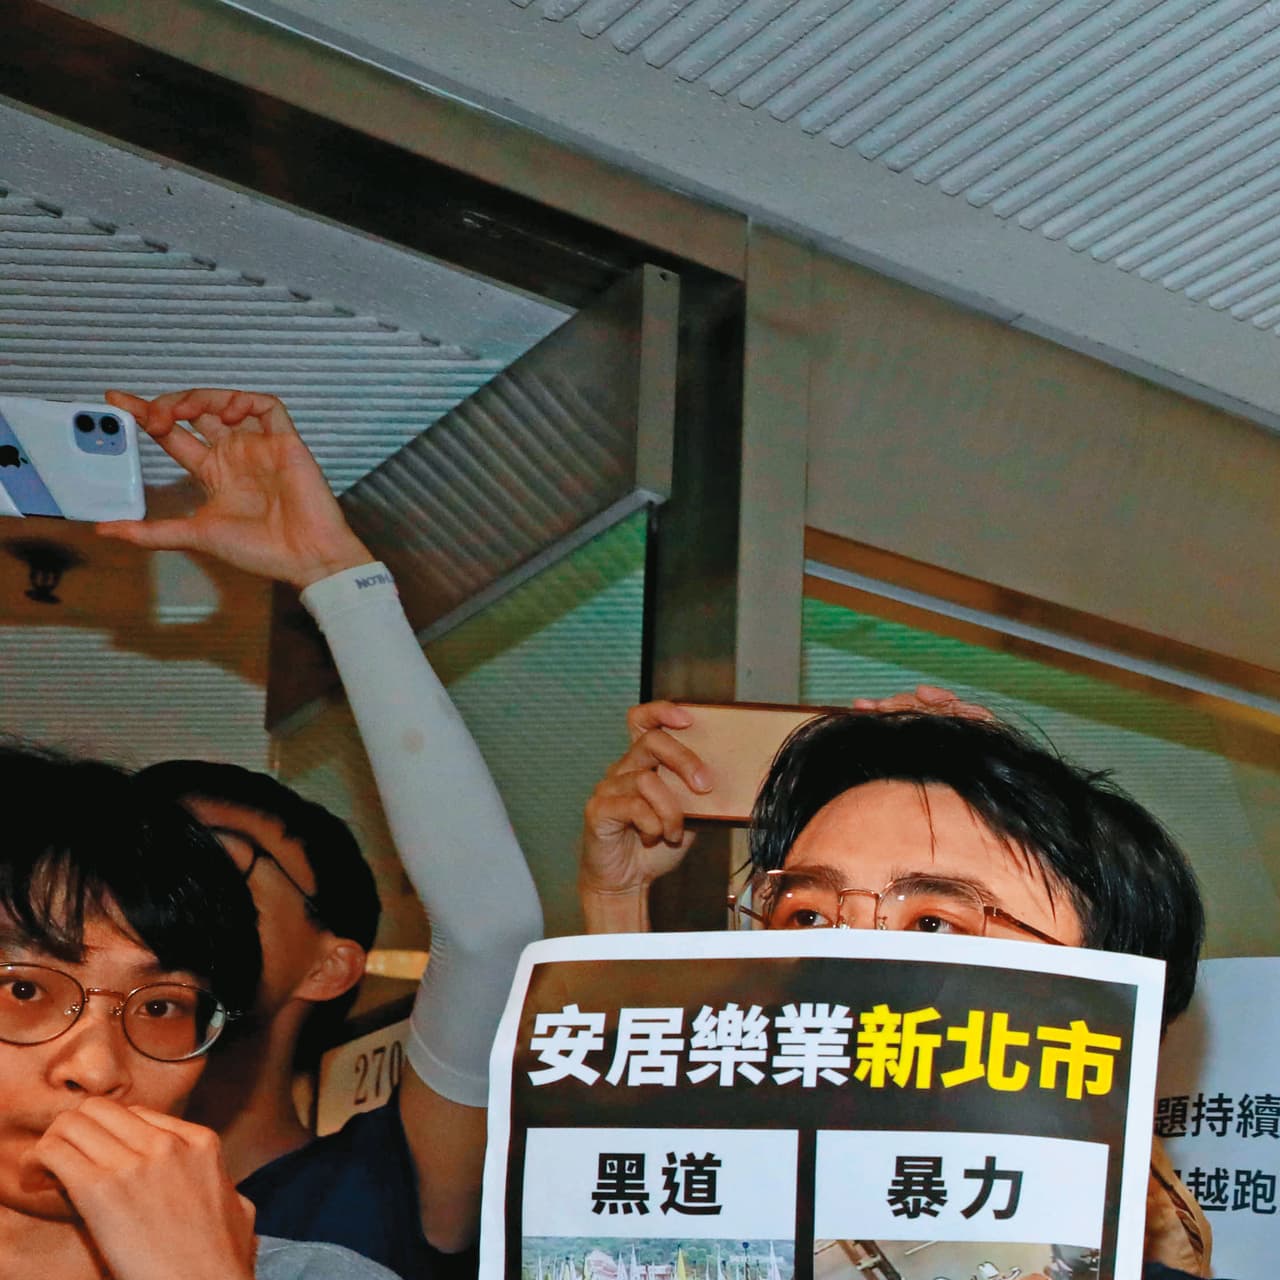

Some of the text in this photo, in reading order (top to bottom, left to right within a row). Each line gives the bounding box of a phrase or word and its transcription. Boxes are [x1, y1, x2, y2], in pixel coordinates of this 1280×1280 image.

[527, 1003, 1121, 1100] 安居樂業新北市
[591, 1152, 723, 1216] 黑道
[886, 1155, 1024, 1220] 暴力
